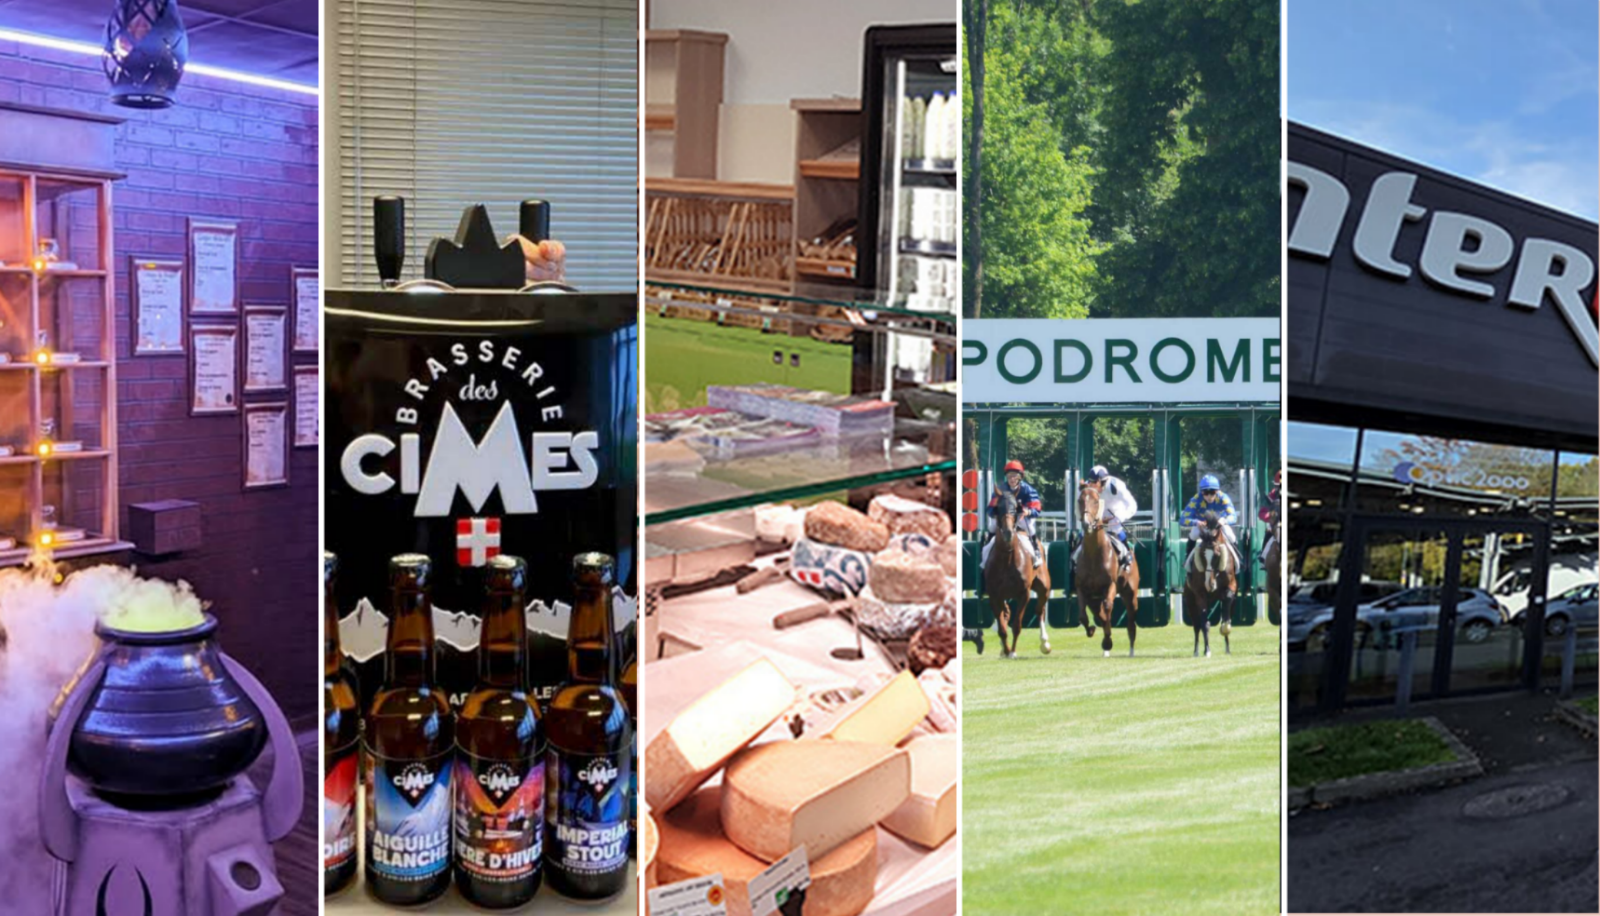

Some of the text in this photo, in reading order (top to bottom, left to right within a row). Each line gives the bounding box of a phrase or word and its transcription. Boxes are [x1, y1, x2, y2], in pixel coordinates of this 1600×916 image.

[963, 337, 1280, 384] PODROME
[396, 340, 563, 424] BRASSERIE
[459, 373, 498, 400] des
[340, 399, 599, 517] CIMES
[1475, 468, 1530, 490] 2000
[373, 825, 449, 852] AIGUILLE
[556, 820, 628, 845] IMPERIAL
[372, 841, 449, 868] BLANCHE
[567, 840, 623, 862] STOUT
